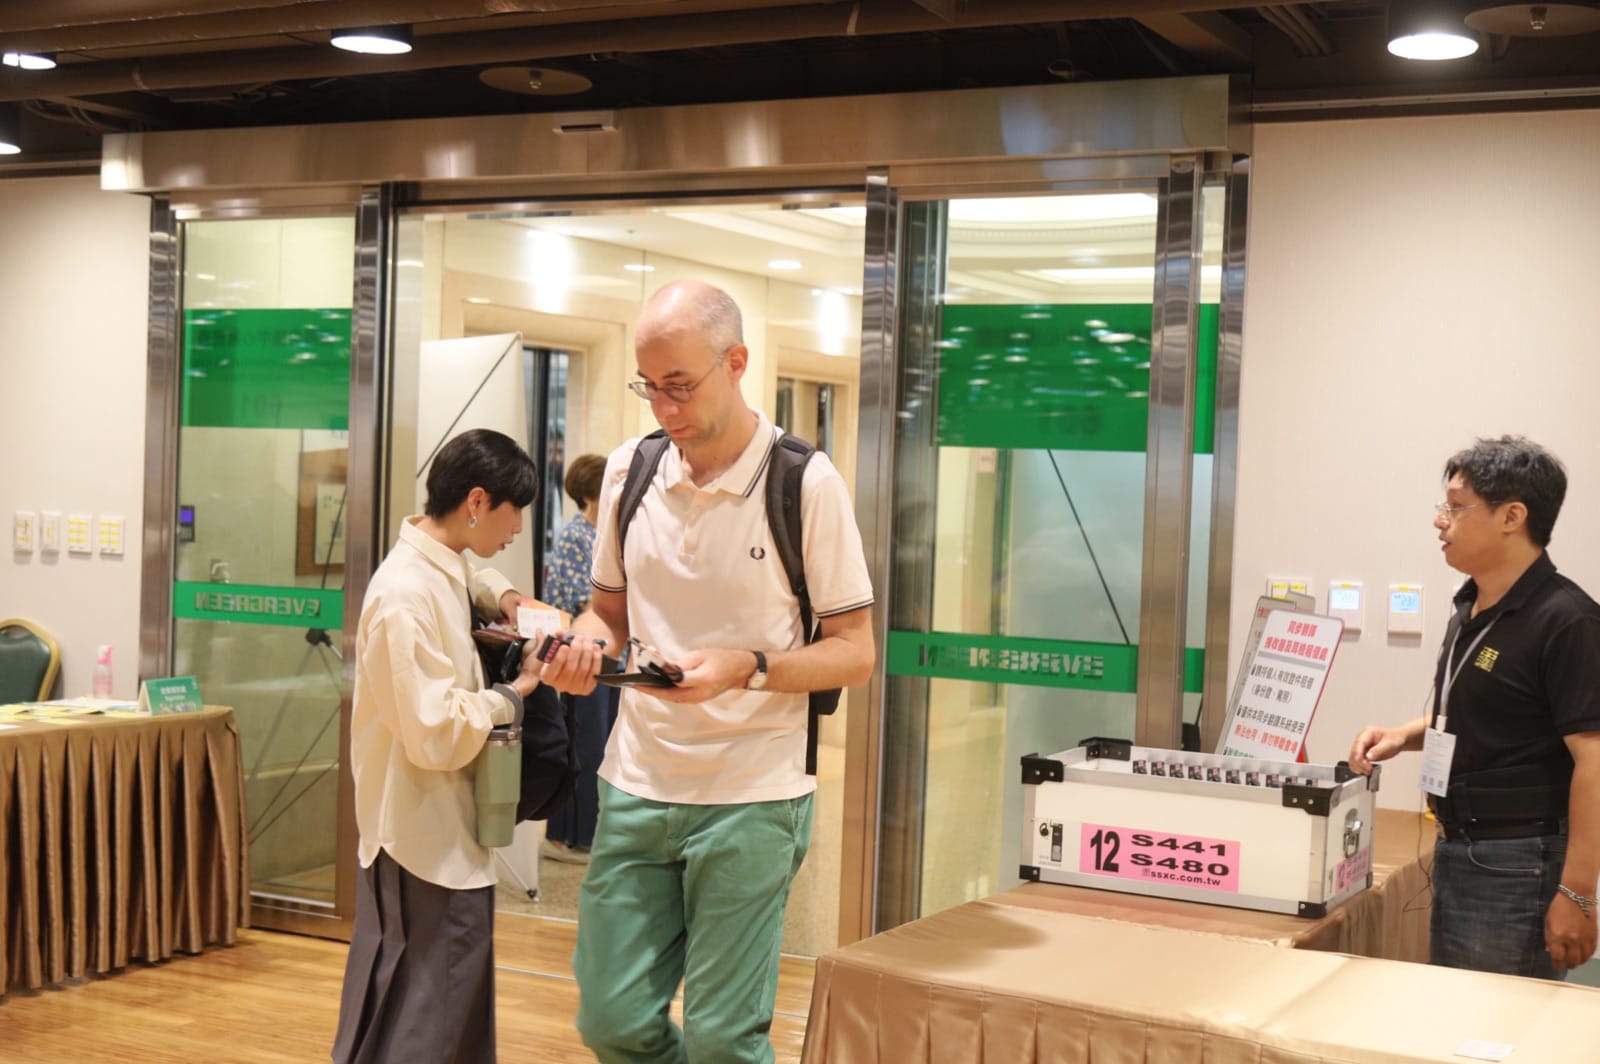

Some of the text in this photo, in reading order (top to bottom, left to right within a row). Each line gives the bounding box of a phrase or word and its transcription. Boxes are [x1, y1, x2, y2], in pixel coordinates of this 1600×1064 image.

[1090, 829, 1120, 873] 12
[1130, 833, 1226, 857] S441
[1129, 853, 1230, 877] S480
[1150, 870, 1222, 887] ssxc.com.tw
